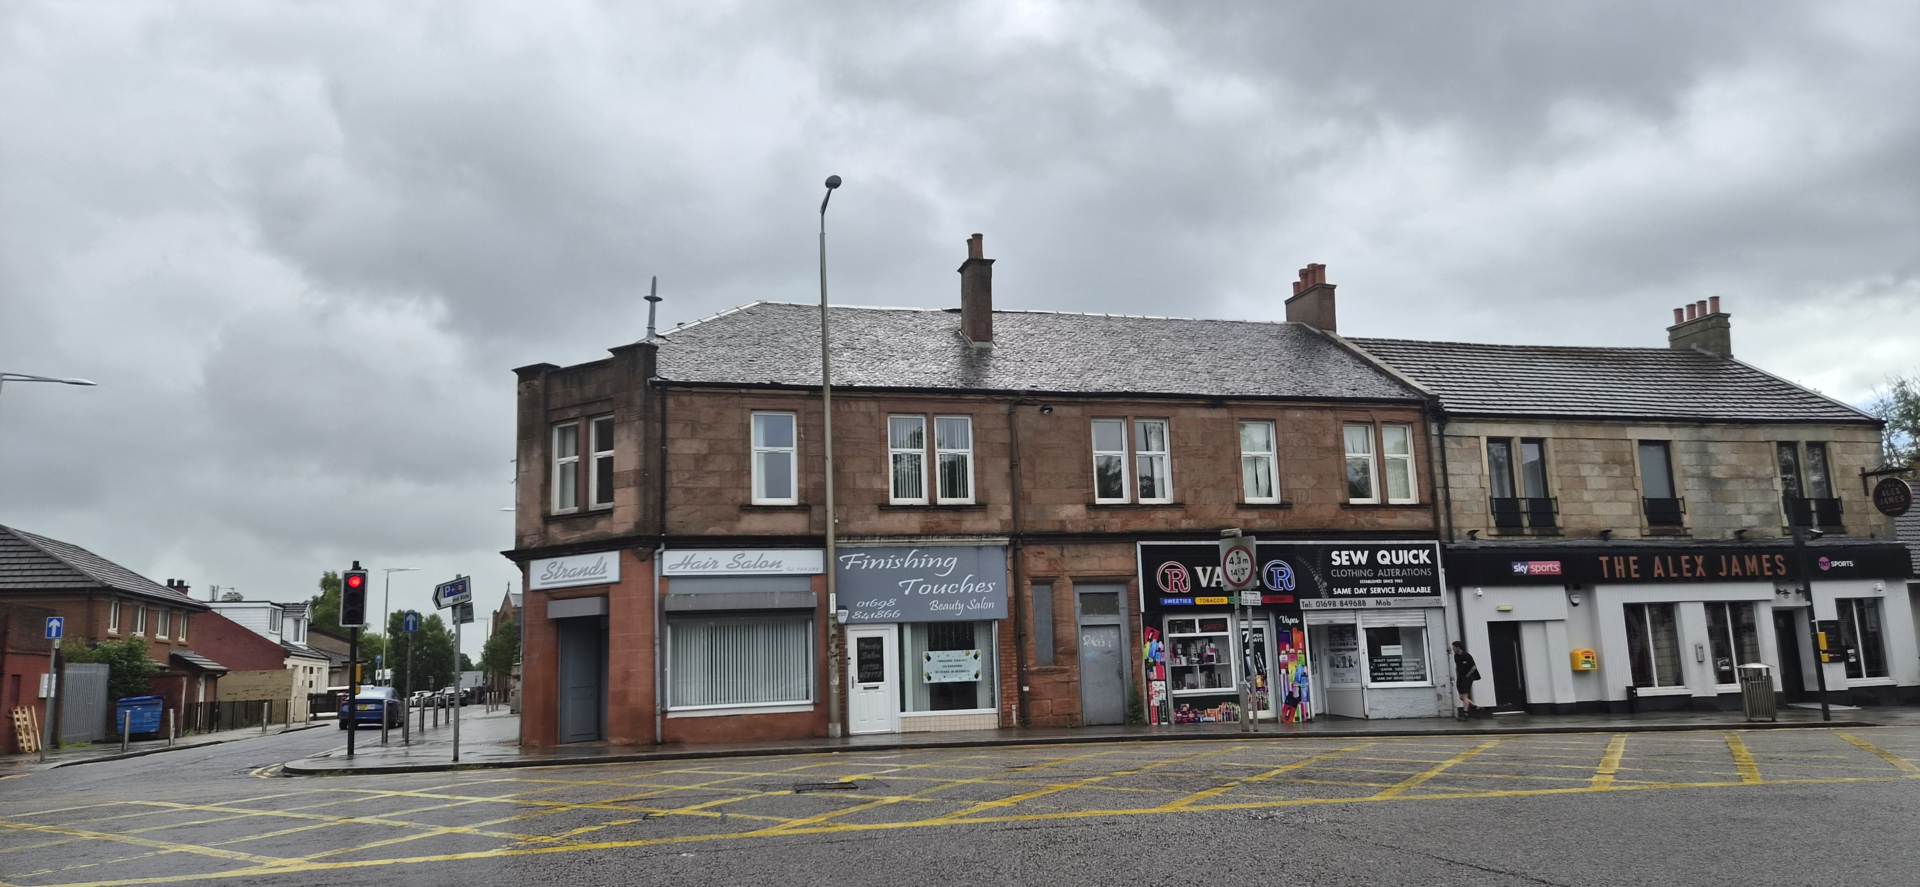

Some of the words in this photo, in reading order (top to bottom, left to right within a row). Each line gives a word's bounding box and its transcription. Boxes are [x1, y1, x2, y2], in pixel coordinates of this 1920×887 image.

[668, 553, 719, 570] Hair
[726, 552, 784, 569] Salon
[839, 549, 958, 577] Finishing
[1331, 550, 1369, 566] SEW
[1376, 549, 1432, 565] QUICK
[540, 556, 608, 581] Strands
[1513, 562, 1528, 574] sky
[1530, 563, 1560, 575] sports
[1598, 556, 1640, 579] THE
[1653, 555, 1706, 578] ALEX
[1718, 554, 1787, 577] JAMES
[1830, 560, 1854, 568] SPORTS
[1331, 569, 1374, 578] CLOTHING
[1377, 568, 1432, 577] ALTERATIONS
[898, 574, 997, 595] Touches
[1333, 587, 1352, 595] SAME
[1398, 586, 1432, 594] AVAILABLE
[856, 598, 897, 610] 01698
[929, 600, 964, 616] Beauty
[967, 597, 995, 610] Salon
[1315, 600, 1337, 608] 01698
[1375, 599, 1391, 607] Mob
[851, 609, 901, 621] 841866
[1280, 615, 1299, 625] Vapes
[1242, 631, 1249, 643] 7
